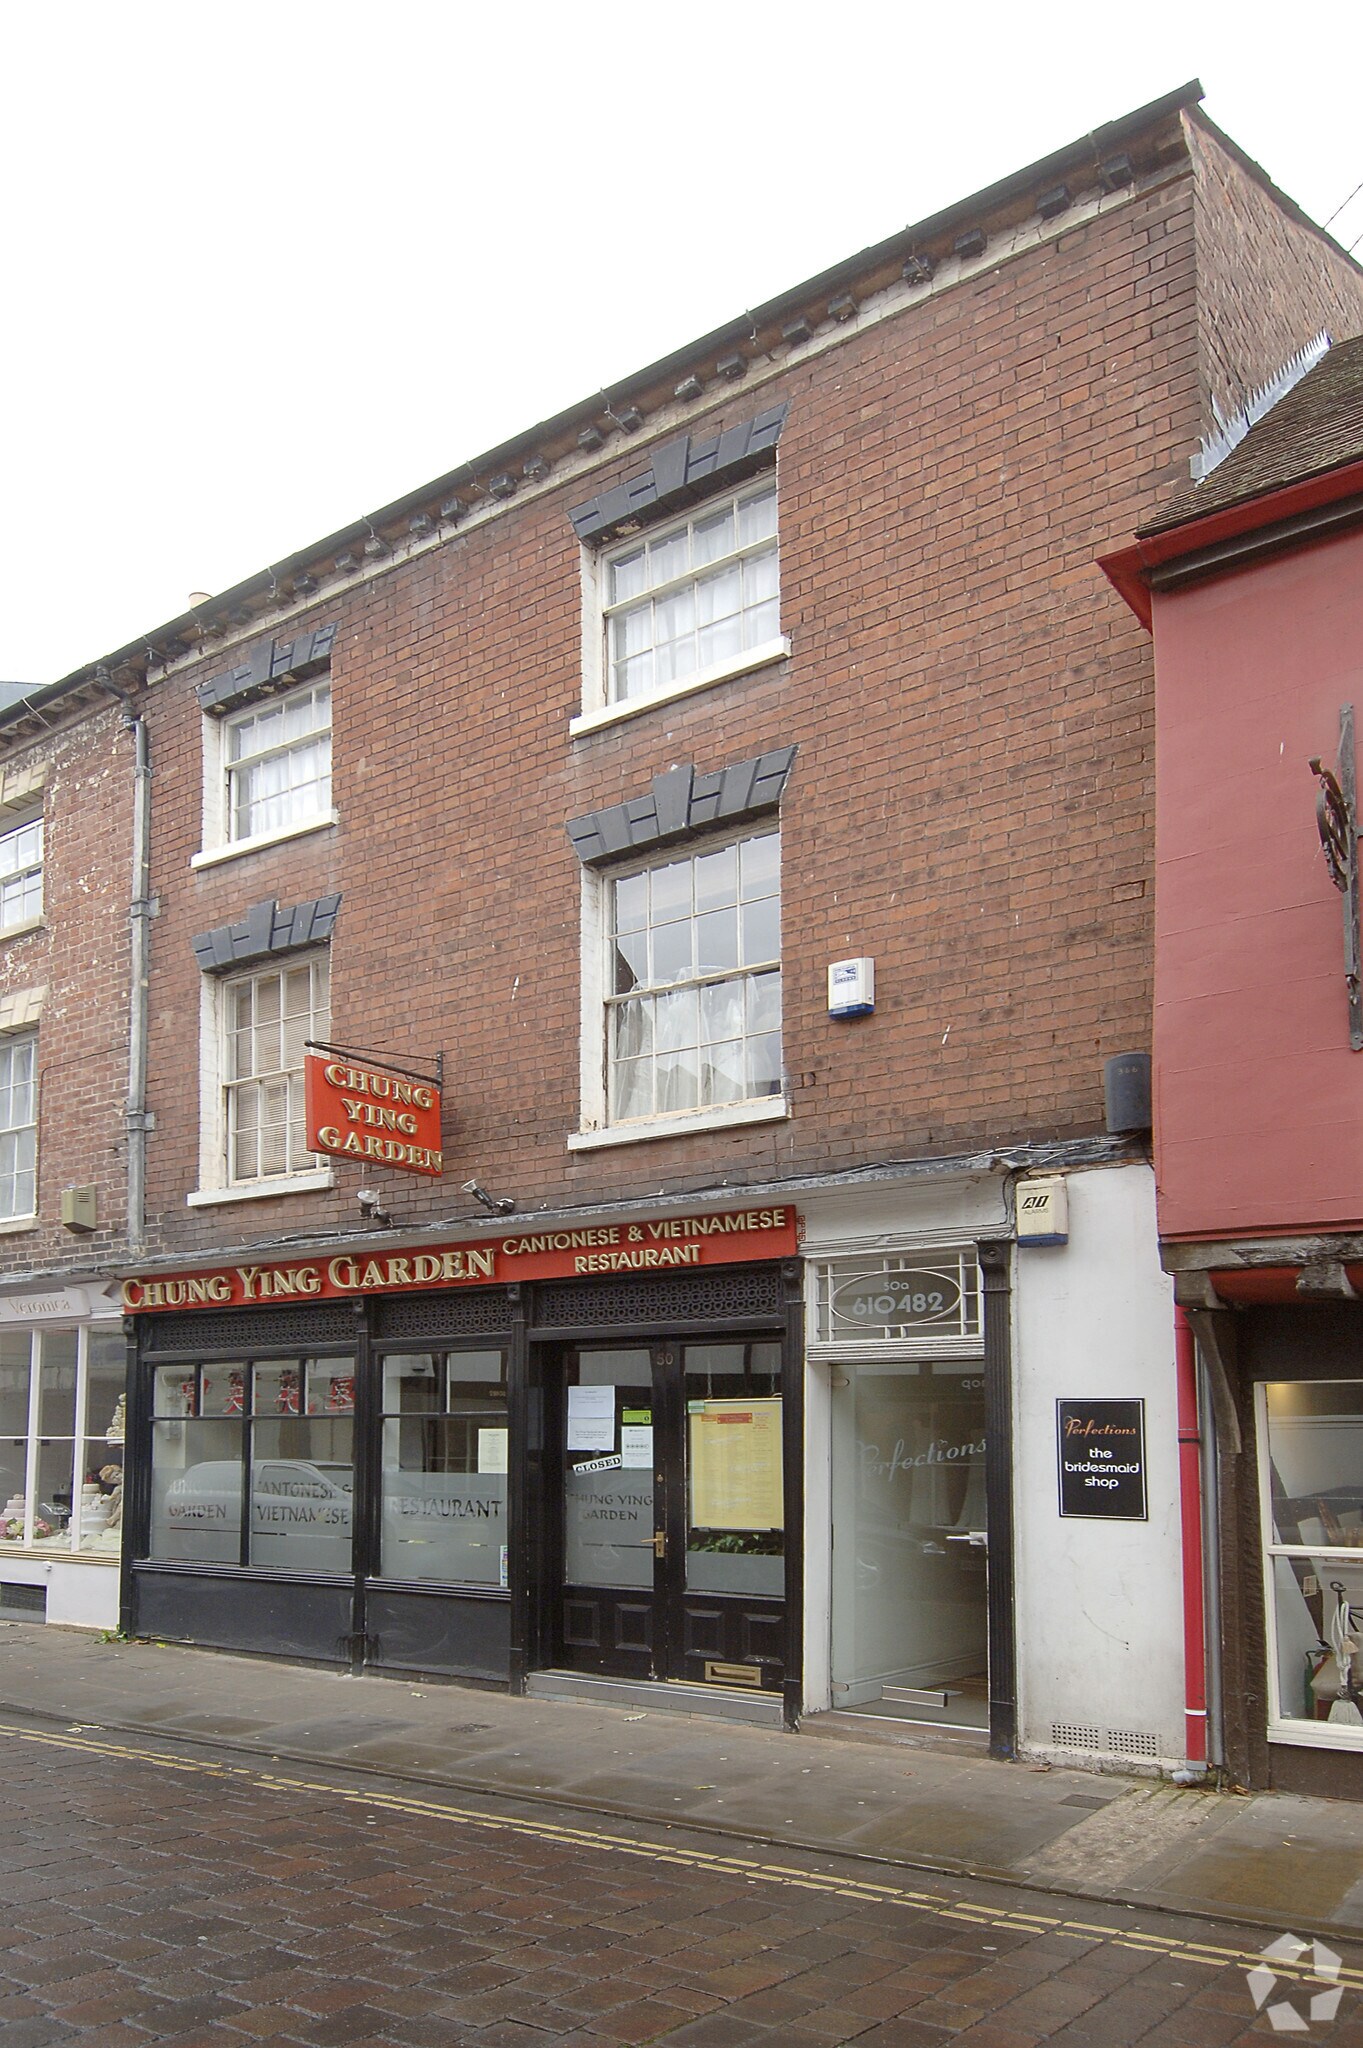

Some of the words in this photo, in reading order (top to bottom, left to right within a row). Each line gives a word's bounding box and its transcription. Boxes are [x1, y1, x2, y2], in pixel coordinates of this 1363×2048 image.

[324, 1064, 434, 1110] CHUNG
[341, 1098, 418, 1136] YING
[317, 1126, 443, 1172] GARDEN
[502, 1227, 620, 1256] CANTONESE
[627, 1225, 645, 1242] &
[648, 1209, 786, 1239] VIETNAMESE
[574, 1244, 701, 1274] RESTAURANT
[121, 1276, 231, 1308] CHUNG
[237, 1267, 321, 1299] YING
[328, 1248, 495, 1289] GARDEN
[883, 1281, 910, 1291] 50a
[8, 1298, 72, 1314] Veronica
[852, 1291, 944, 1316] 610482
[657, 1352, 674, 1366] 50
[1065, 1415, 1137, 1438] Perfections
[856, 1438, 986, 1482] Perfections
[1089, 1447, 1113, 1459] the
[575, 1457, 621, 1474] CLOSED
[1064, 1460, 1140, 1474] bridesmaid
[1084, 1475, 1119, 1490] shop
[388, 1496, 504, 1518] RESTAURANT
[569, 1493, 614, 1505] HUNG
[617, 1494, 654, 1506] YING
